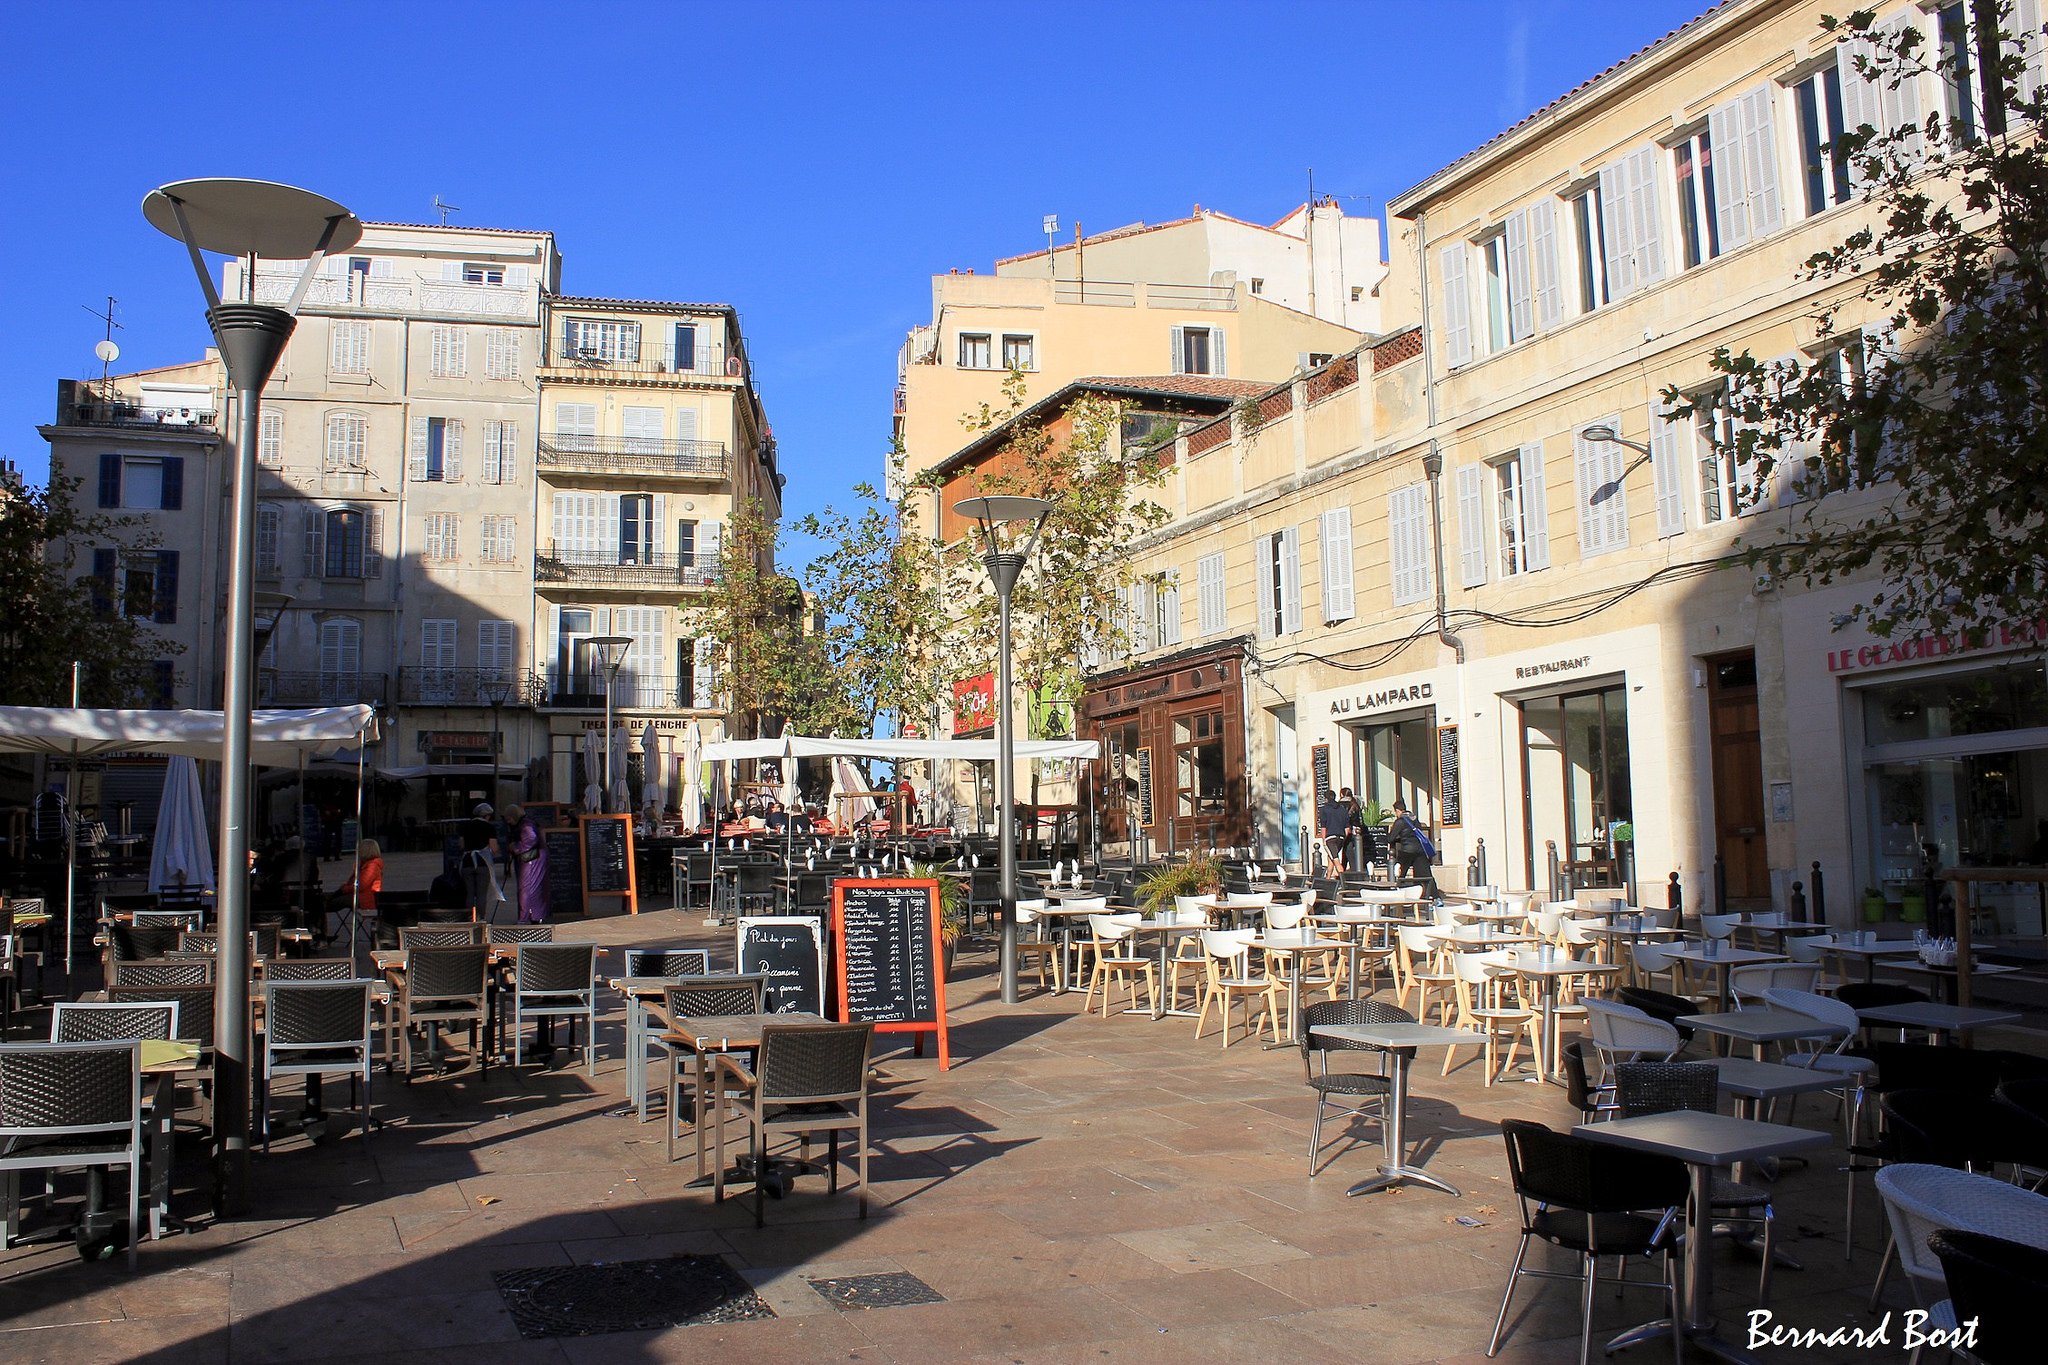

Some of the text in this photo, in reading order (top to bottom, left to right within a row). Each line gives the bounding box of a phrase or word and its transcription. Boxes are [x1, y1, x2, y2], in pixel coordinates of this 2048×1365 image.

[1515, 656, 1591, 679] RESTAURANT
[1828, 649, 1855, 673] LE
[1330, 683, 1434, 715] AU LAMPARO
[631, 720, 643, 729] DE
